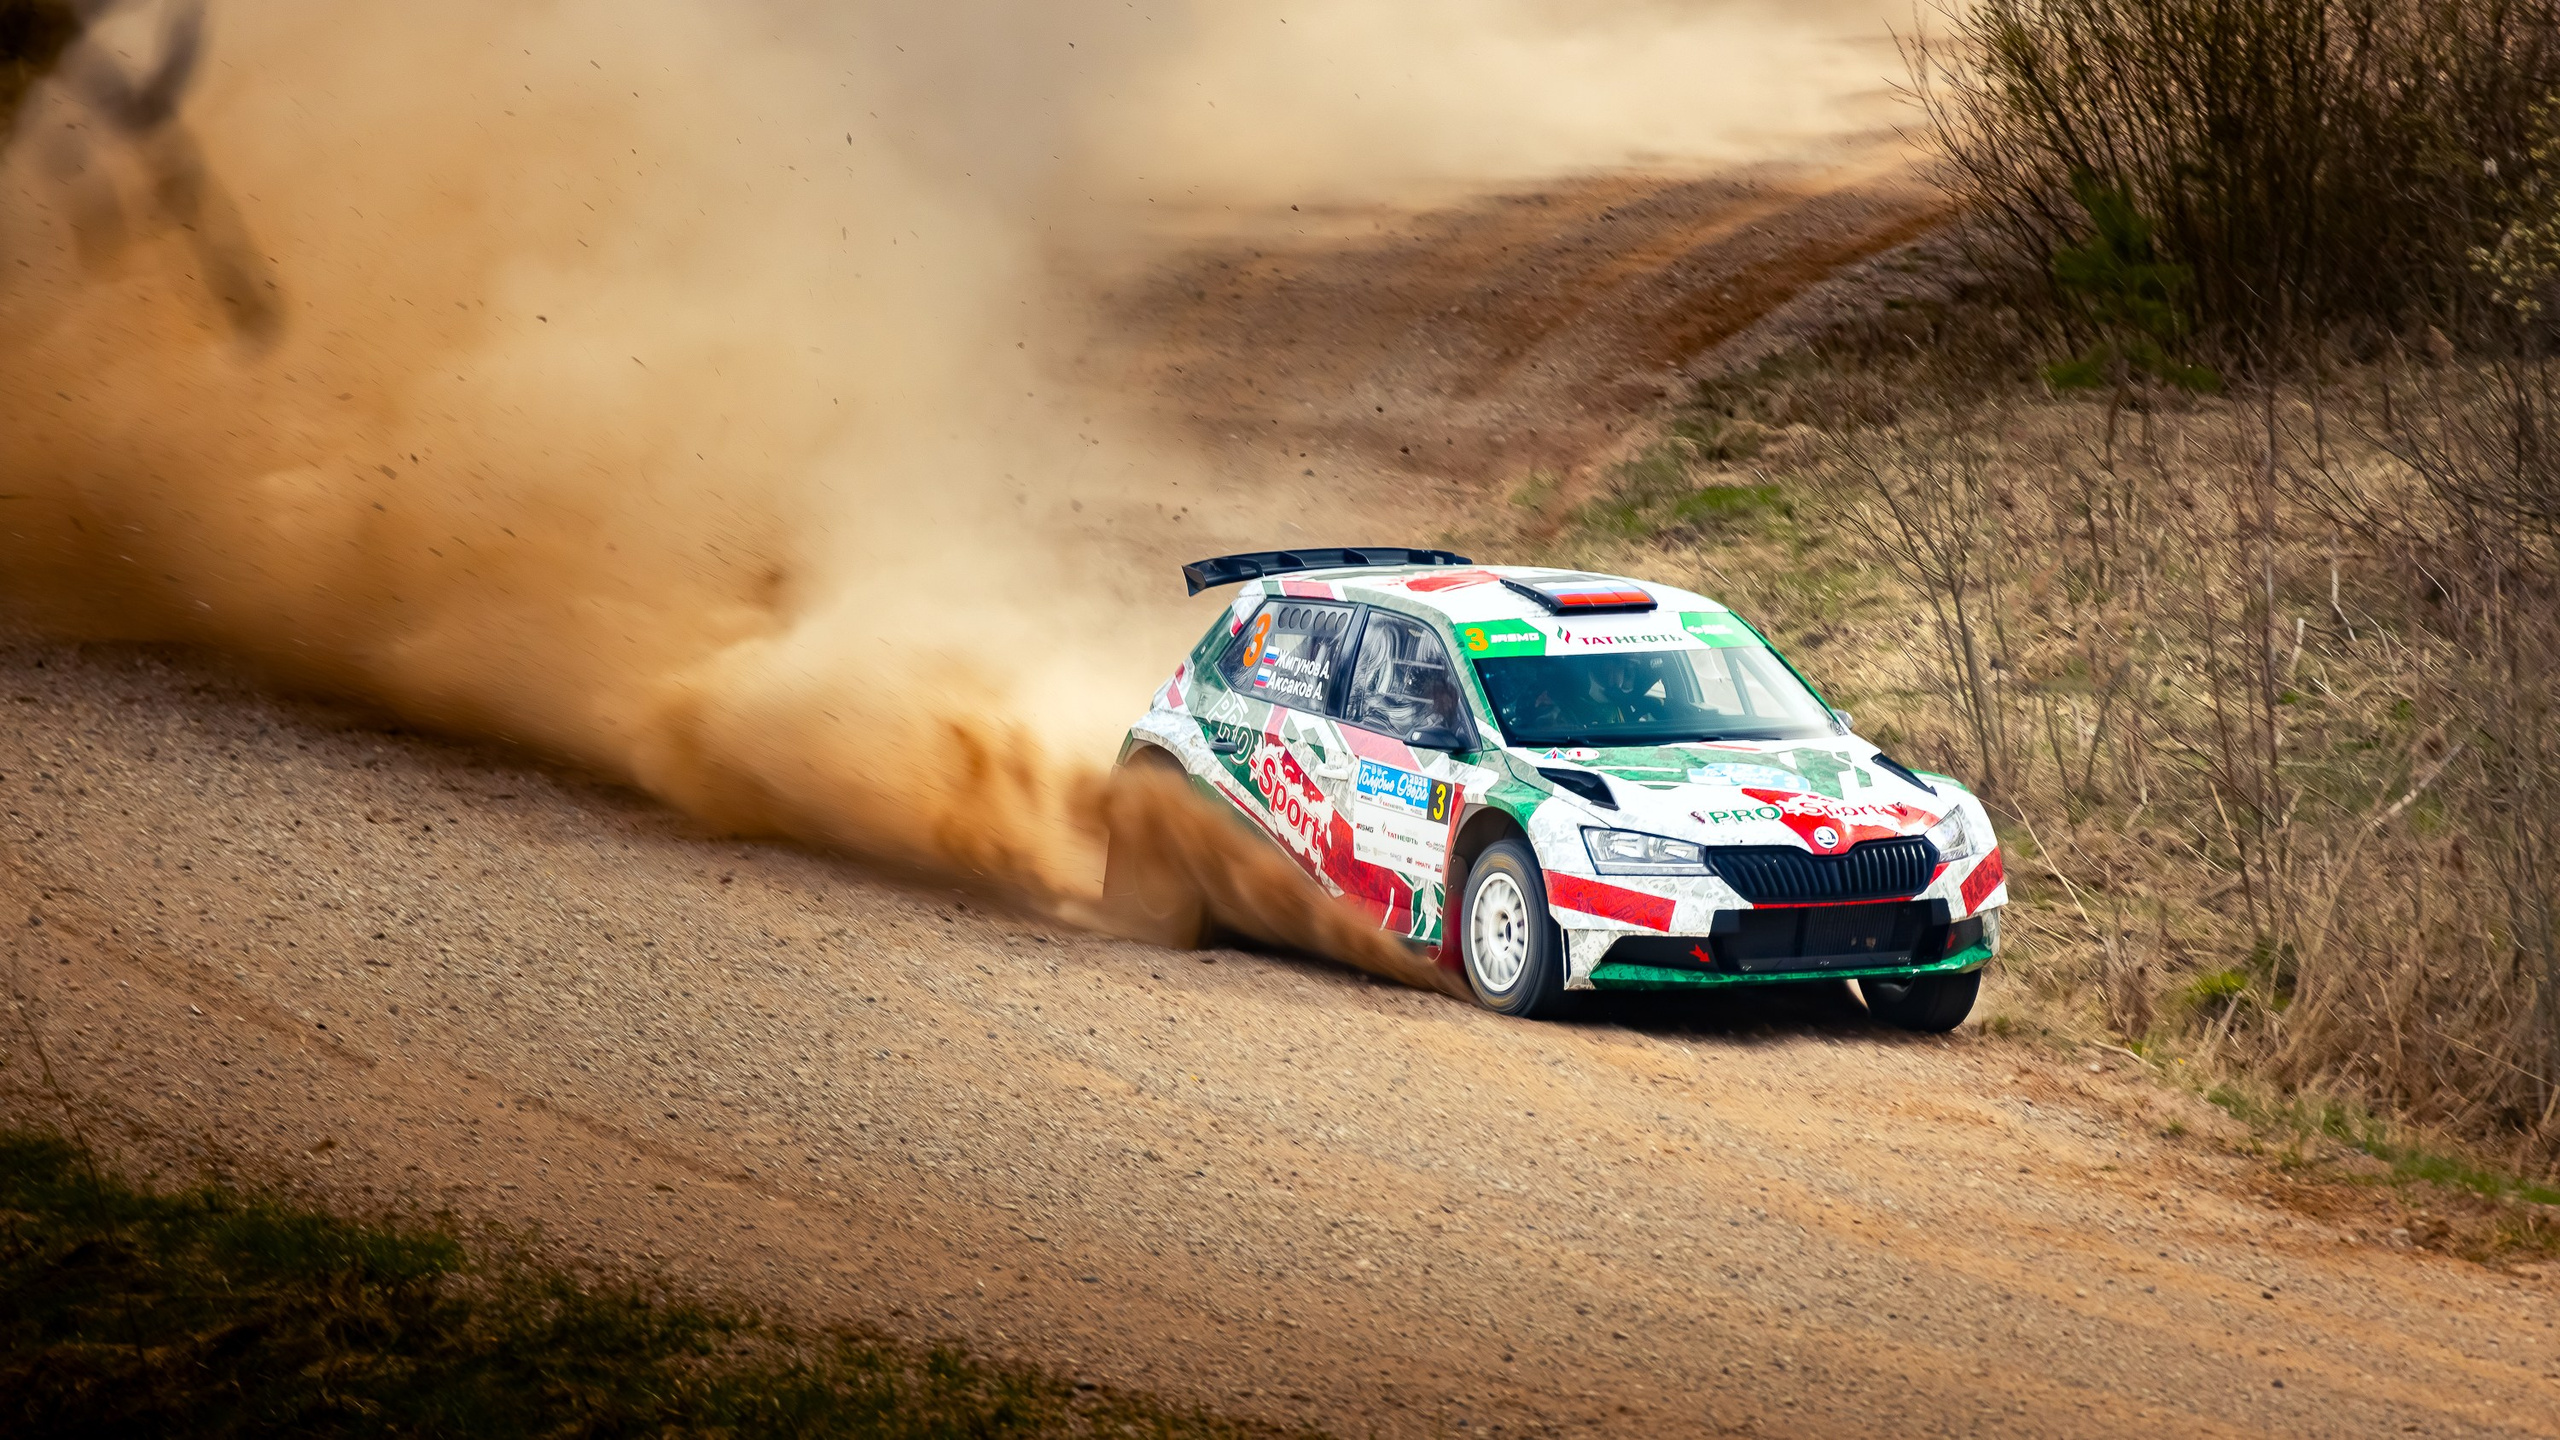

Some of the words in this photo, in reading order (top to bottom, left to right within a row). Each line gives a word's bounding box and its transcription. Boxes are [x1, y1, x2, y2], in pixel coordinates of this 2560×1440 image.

[1243, 613, 1271, 667] 3
[1465, 627, 1489, 651] 3
[1578, 633, 1683, 645] ТАТНЕФТЬ
[1274, 649, 1321, 676] Жигунов
[1320, 660, 1330, 680] А.
[1266, 671, 1314, 698] Аксаков
[1312, 681, 1323, 700] А.
[1433, 783, 1447, 820] 3
[1387, 831, 1419, 846] ТАТНЕФТЬ
